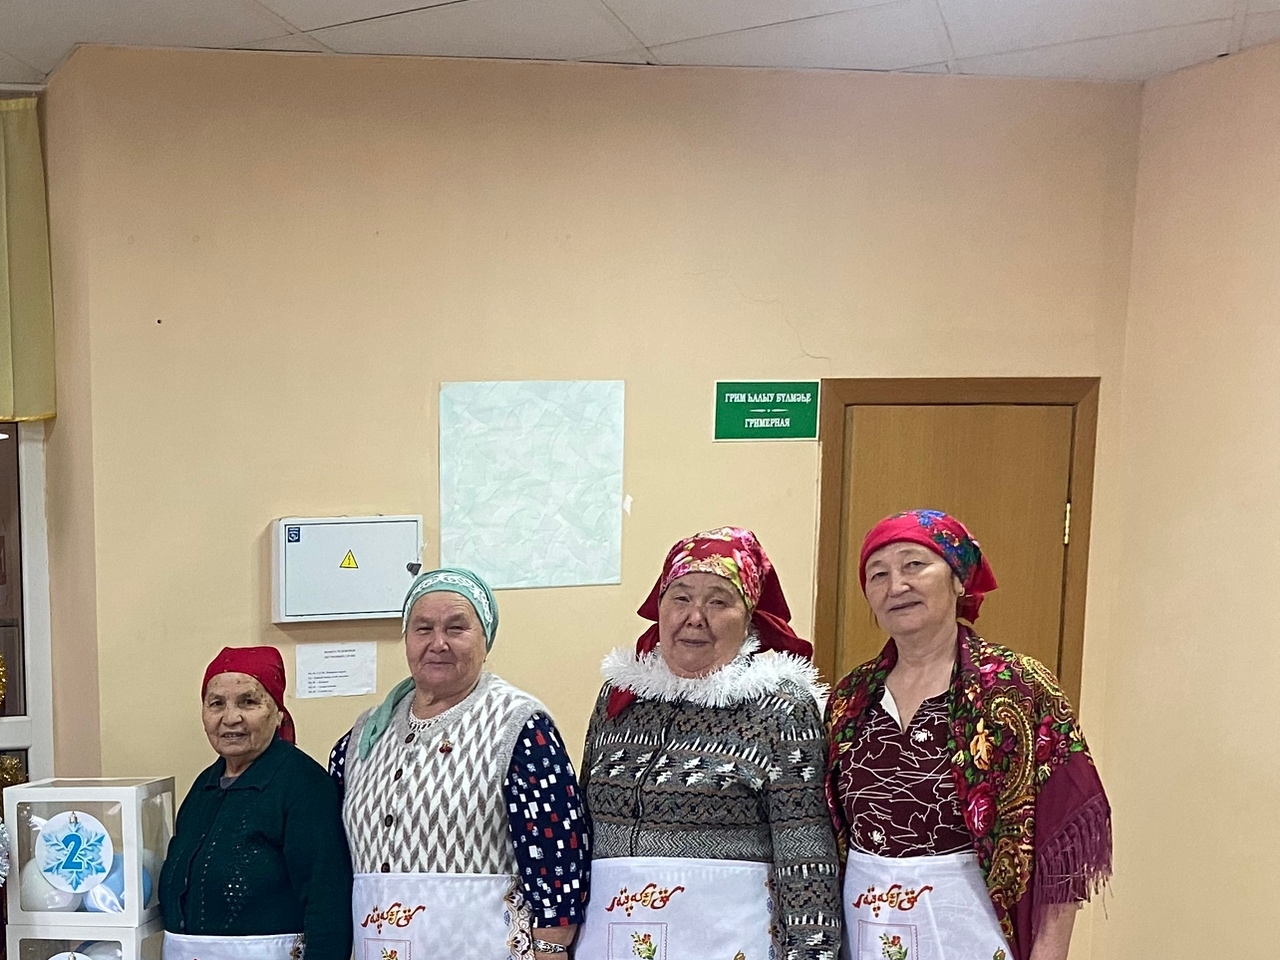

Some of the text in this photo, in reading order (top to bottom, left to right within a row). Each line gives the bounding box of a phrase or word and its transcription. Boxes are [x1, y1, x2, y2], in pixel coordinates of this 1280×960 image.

[724, 393, 746, 403] ГРИМ
[744, 418, 791, 428] ГРИМЕРНАЯ
[61, 832, 83, 870] 2
